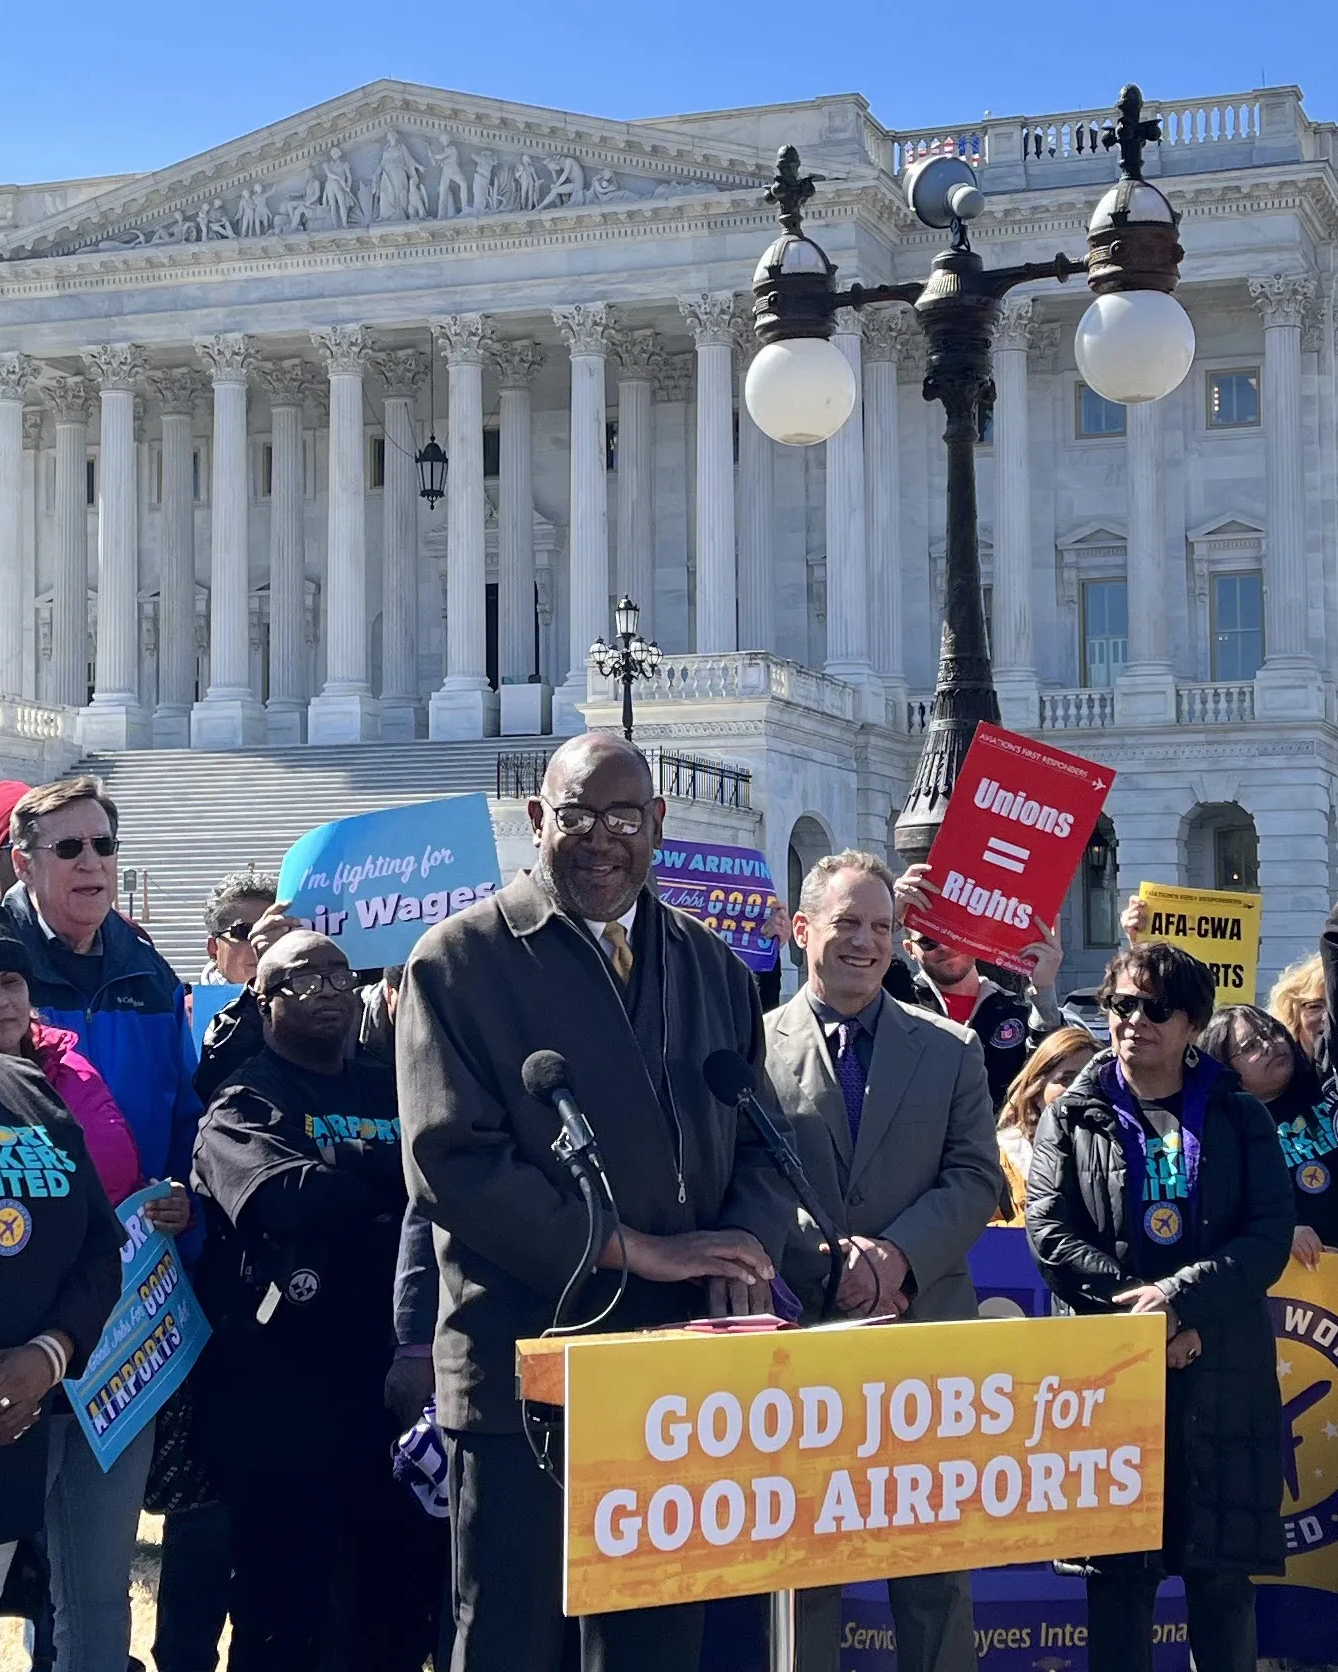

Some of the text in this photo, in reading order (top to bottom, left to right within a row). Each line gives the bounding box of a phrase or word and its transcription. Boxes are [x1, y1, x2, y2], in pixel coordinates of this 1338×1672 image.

[1021, 748, 1042, 760] FIRST
[1042, 755, 1089, 778] RESPONDERS
[973, 777, 1075, 838] Unions
[297, 845, 455, 895] I'm fighting for
[652, 849, 772, 880] OW ARRIVIN
[355, 881, 496, 930] Wages
[941, 870, 1033, 930] Rights
[1150, 912, 1242, 941] AFA-CWA
[139, 1254, 179, 1317] GOOD
[88, 1313, 182, 1435] AIRPORTS
[645, 1373, 1106, 1462] GOOD JOBS for
[593, 1445, 1143, 1557] GOOD AIRPORTS
[840, 1622, 897, 1651] Servic
